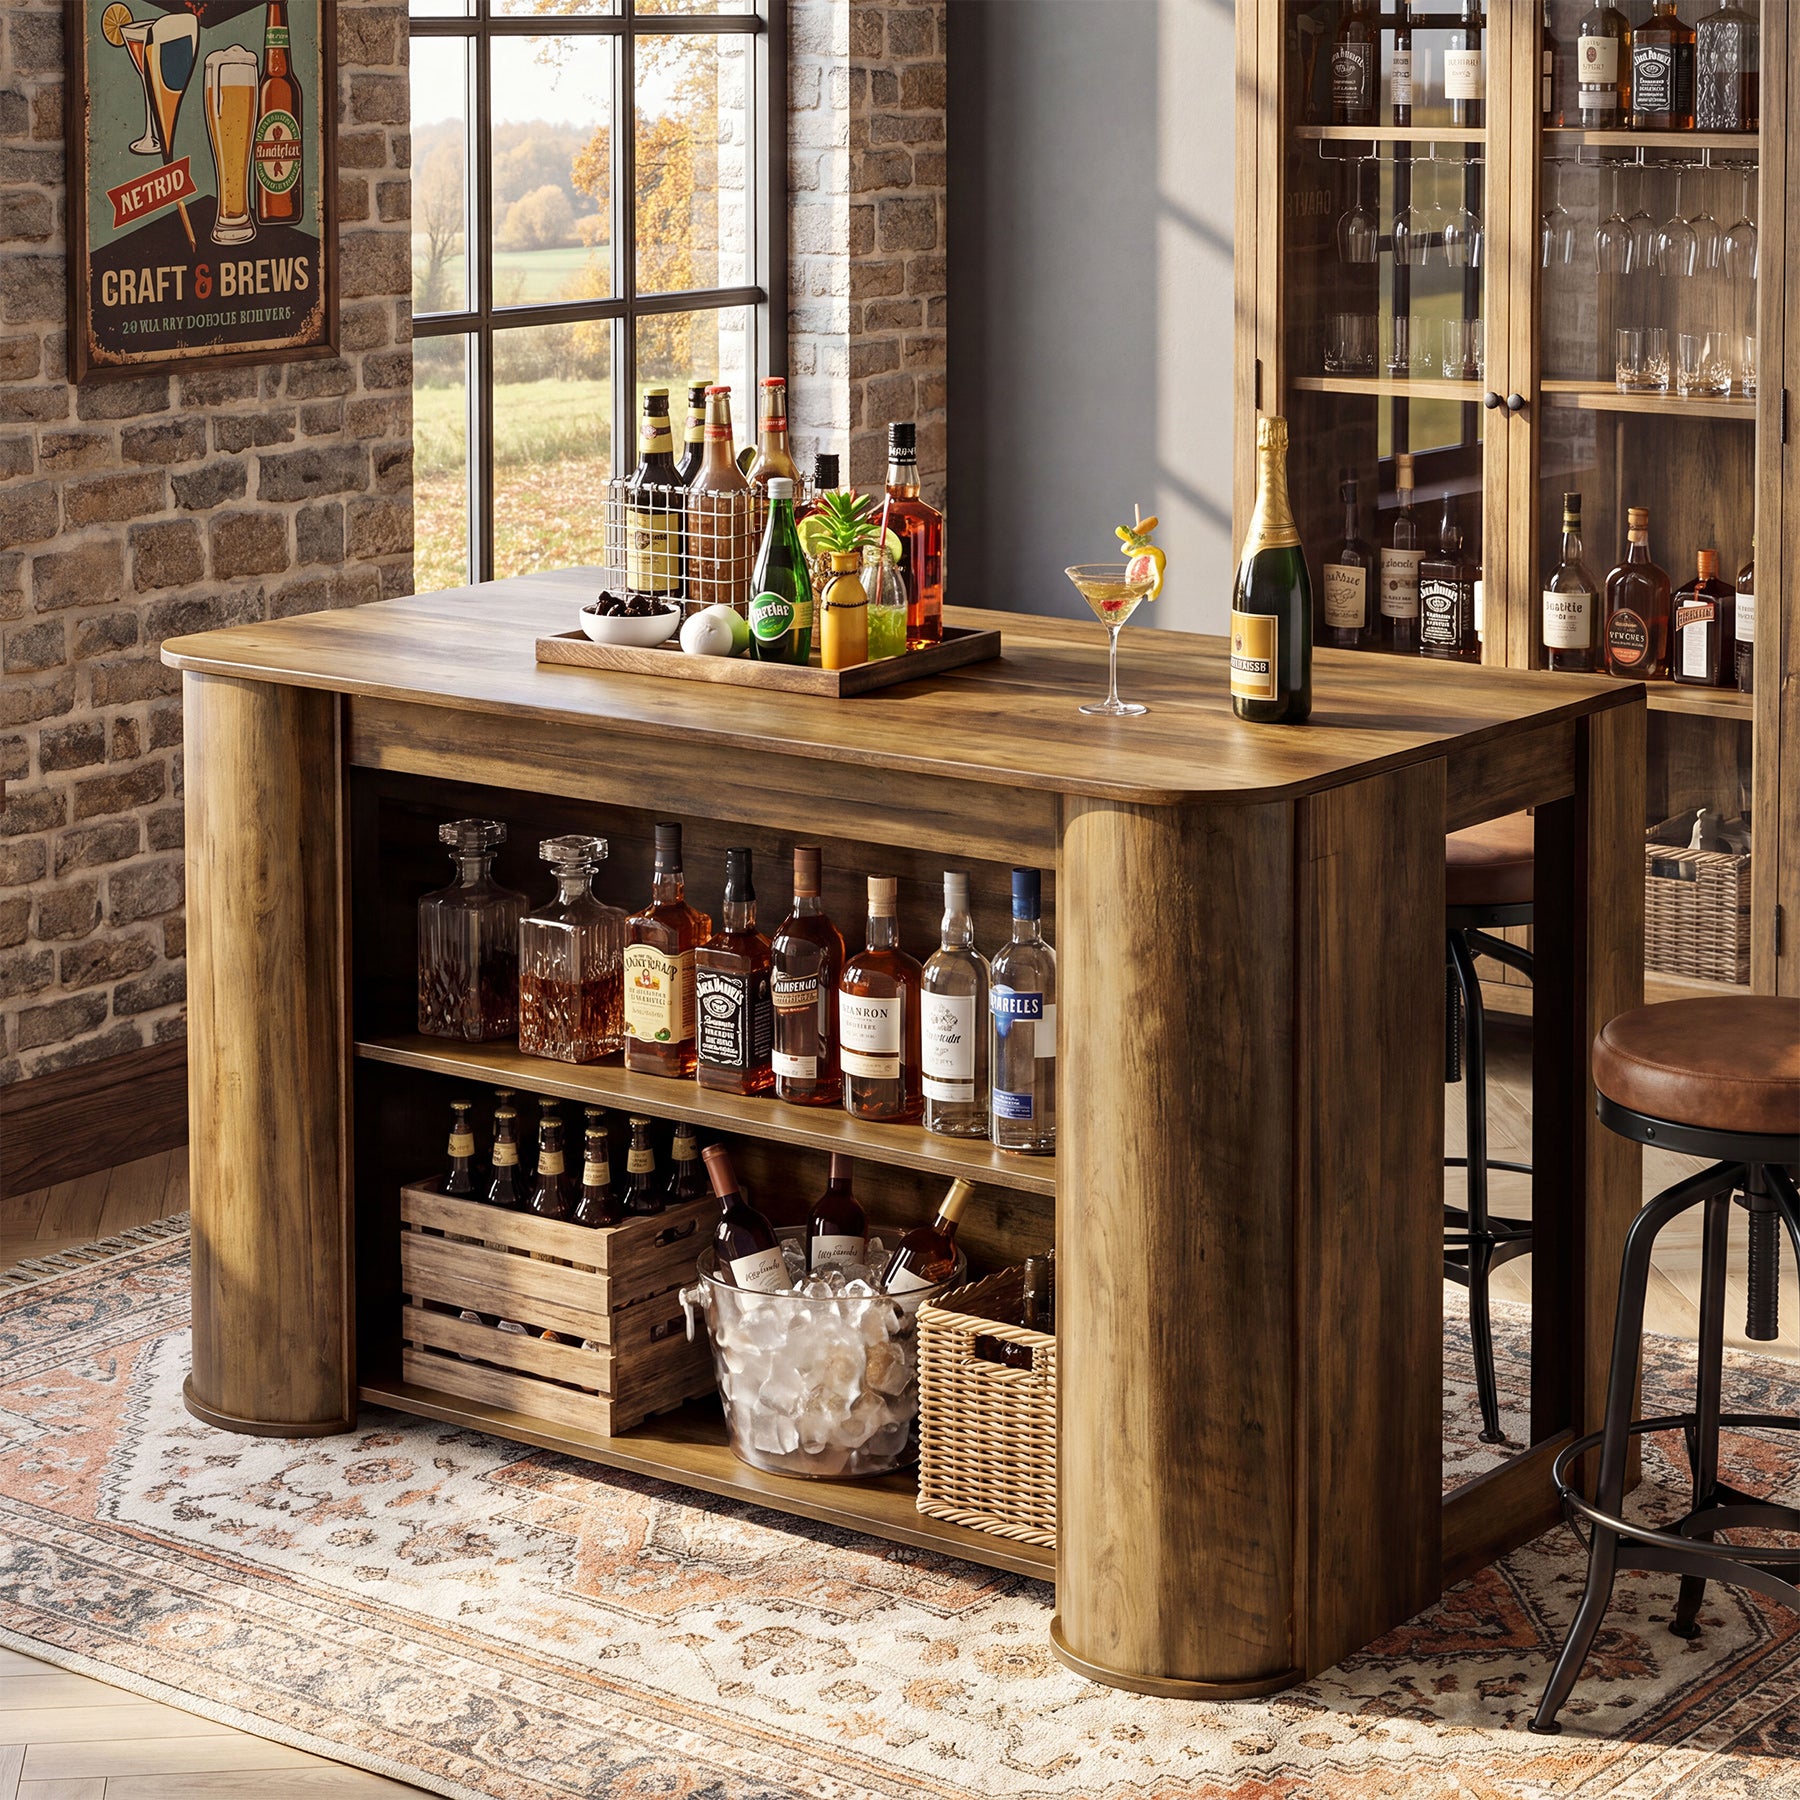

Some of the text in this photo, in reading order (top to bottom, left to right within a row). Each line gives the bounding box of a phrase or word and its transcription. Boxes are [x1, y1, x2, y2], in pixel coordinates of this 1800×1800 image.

[102, 256, 309, 307] CRAFT & BREWS
